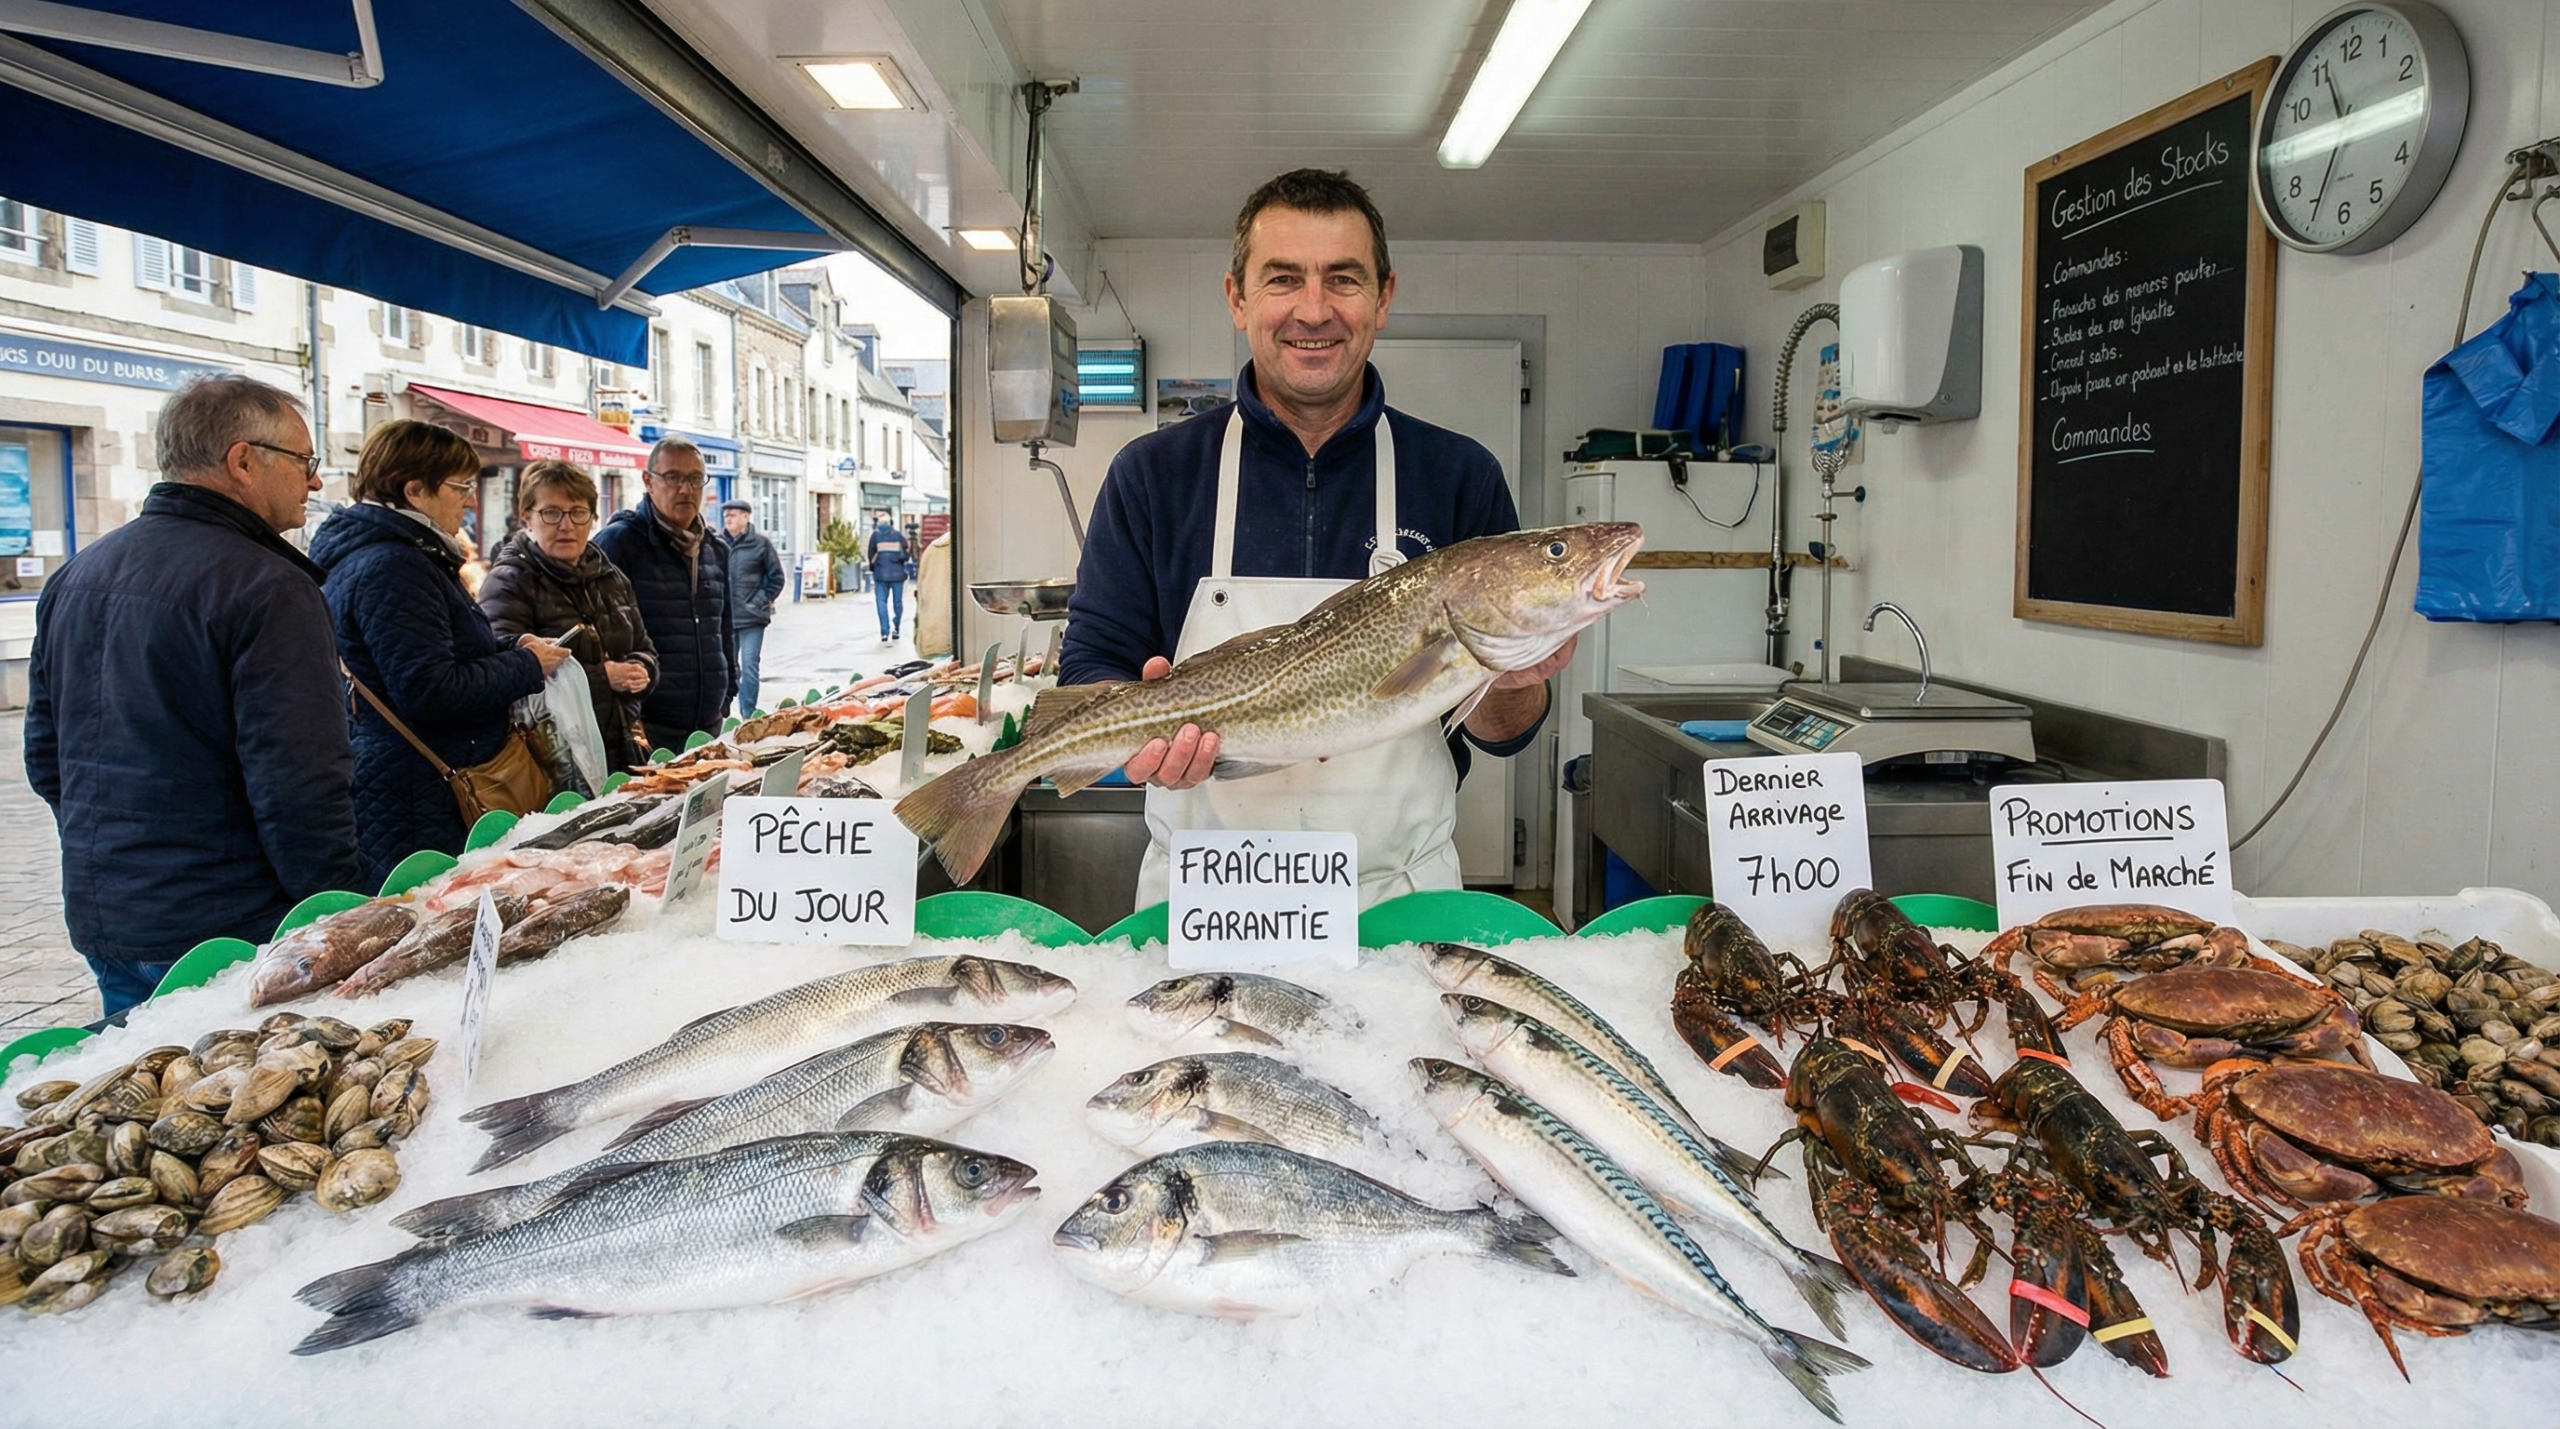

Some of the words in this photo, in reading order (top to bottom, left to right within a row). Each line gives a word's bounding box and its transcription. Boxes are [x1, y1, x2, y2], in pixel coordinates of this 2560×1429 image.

[2340, 34, 2363, 63] 12
[2378, 34, 2387, 58] 1
[2312, 59, 2330, 87] 11
[2398, 54, 2414, 82] 2
[2290, 97, 2311, 124] 10
[2394, 140, 2409, 165] 4
[2051, 184, 2117, 229] Gestion
[2123, 166, 2152, 201] des
[2160, 130, 2230, 187] Stocks
[2289, 176, 2302, 198] 8
[2369, 179, 2384, 204] 5
[2309, 198, 2321, 222] 7
[2338, 201, 2351, 225] 6
[83, 357, 109, 375] DU
[2051, 411, 2152, 452] Commandes
[749, 807, 873, 855] PÊCHE
[1180, 839, 1351, 888] FRAÎCHEUR
[1738, 855, 1840, 896] 7h00
[2067, 861, 2098, 890] de
[730, 888, 777, 924] DU
[794, 887, 889, 925] JOUR
